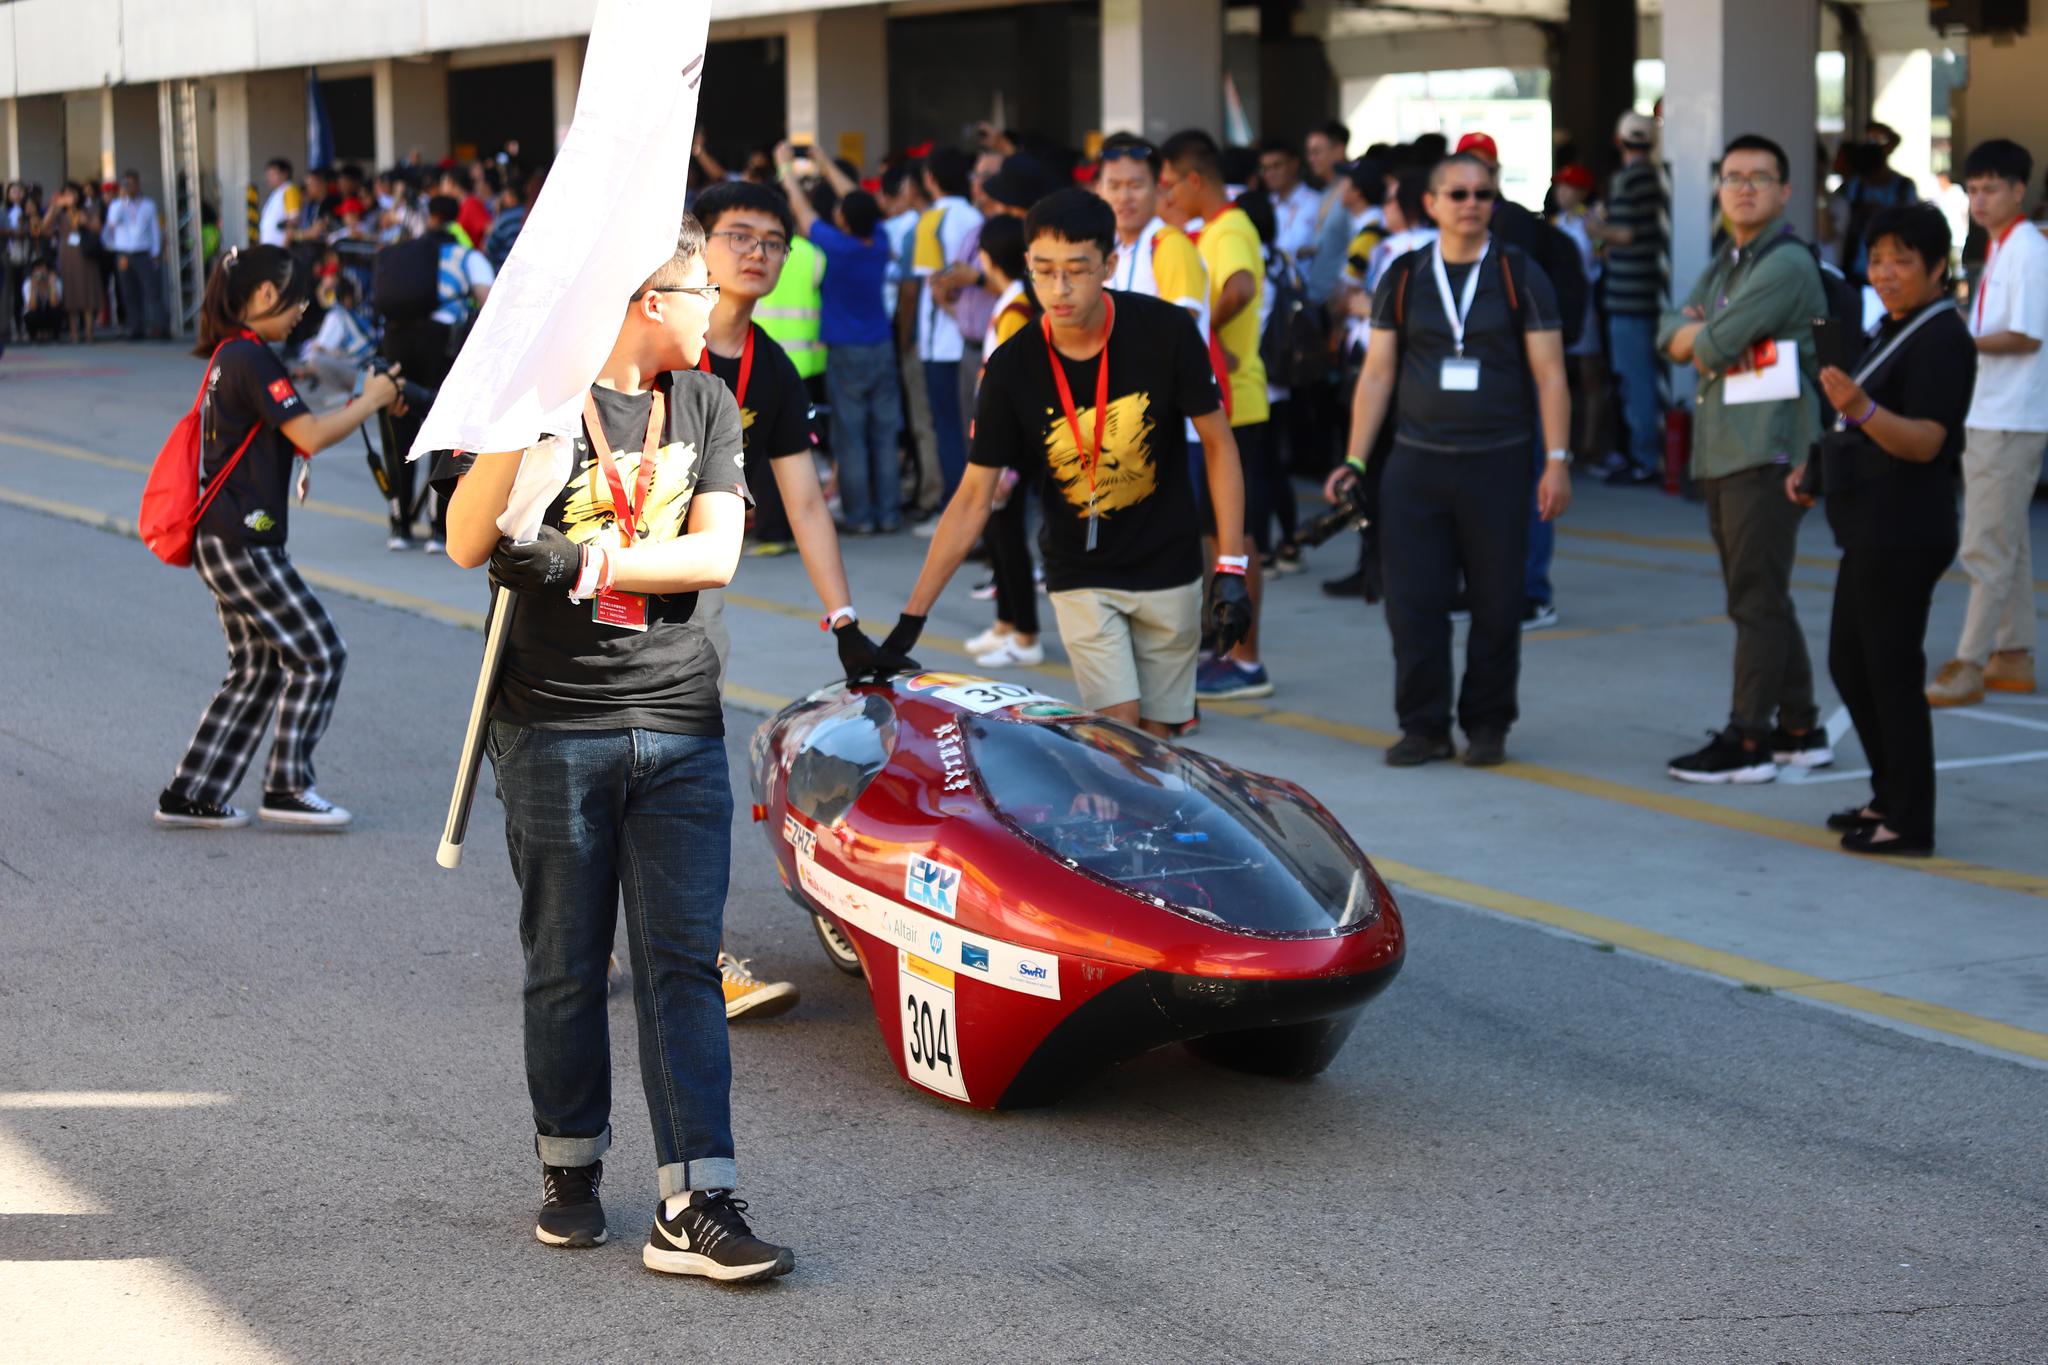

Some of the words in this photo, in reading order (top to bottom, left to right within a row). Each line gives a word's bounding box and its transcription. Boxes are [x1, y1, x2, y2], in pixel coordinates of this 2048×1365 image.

[907, 856, 957, 915] EKK
[893, 918, 918, 943] Altair
[1018, 962, 1047, 979] SwRI
[907, 994, 953, 1077] 304
